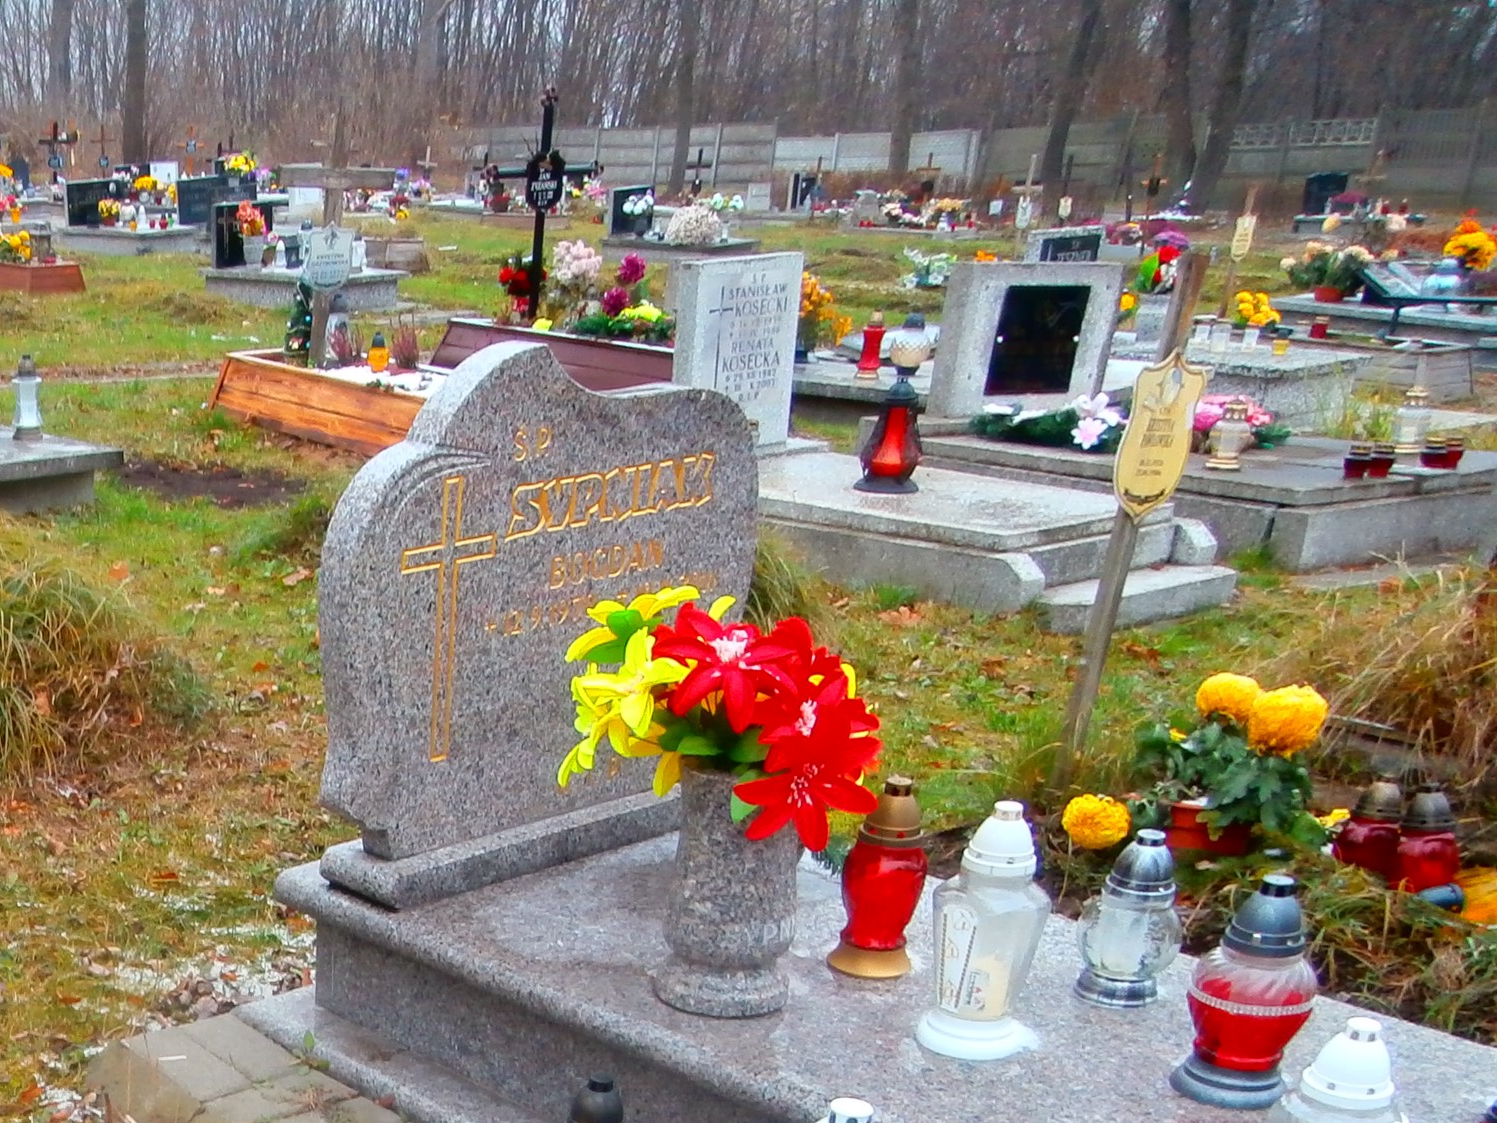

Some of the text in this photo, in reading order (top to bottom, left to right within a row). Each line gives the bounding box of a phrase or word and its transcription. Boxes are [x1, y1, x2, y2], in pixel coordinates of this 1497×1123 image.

[728, 283, 788, 300] STANISŁAW
[735, 296, 788, 318] KOSECKI
[731, 338, 774, 354] RENATA
[722, 351, 780, 373] KOSECKA
[550, 539, 665, 590] BOGDAN
